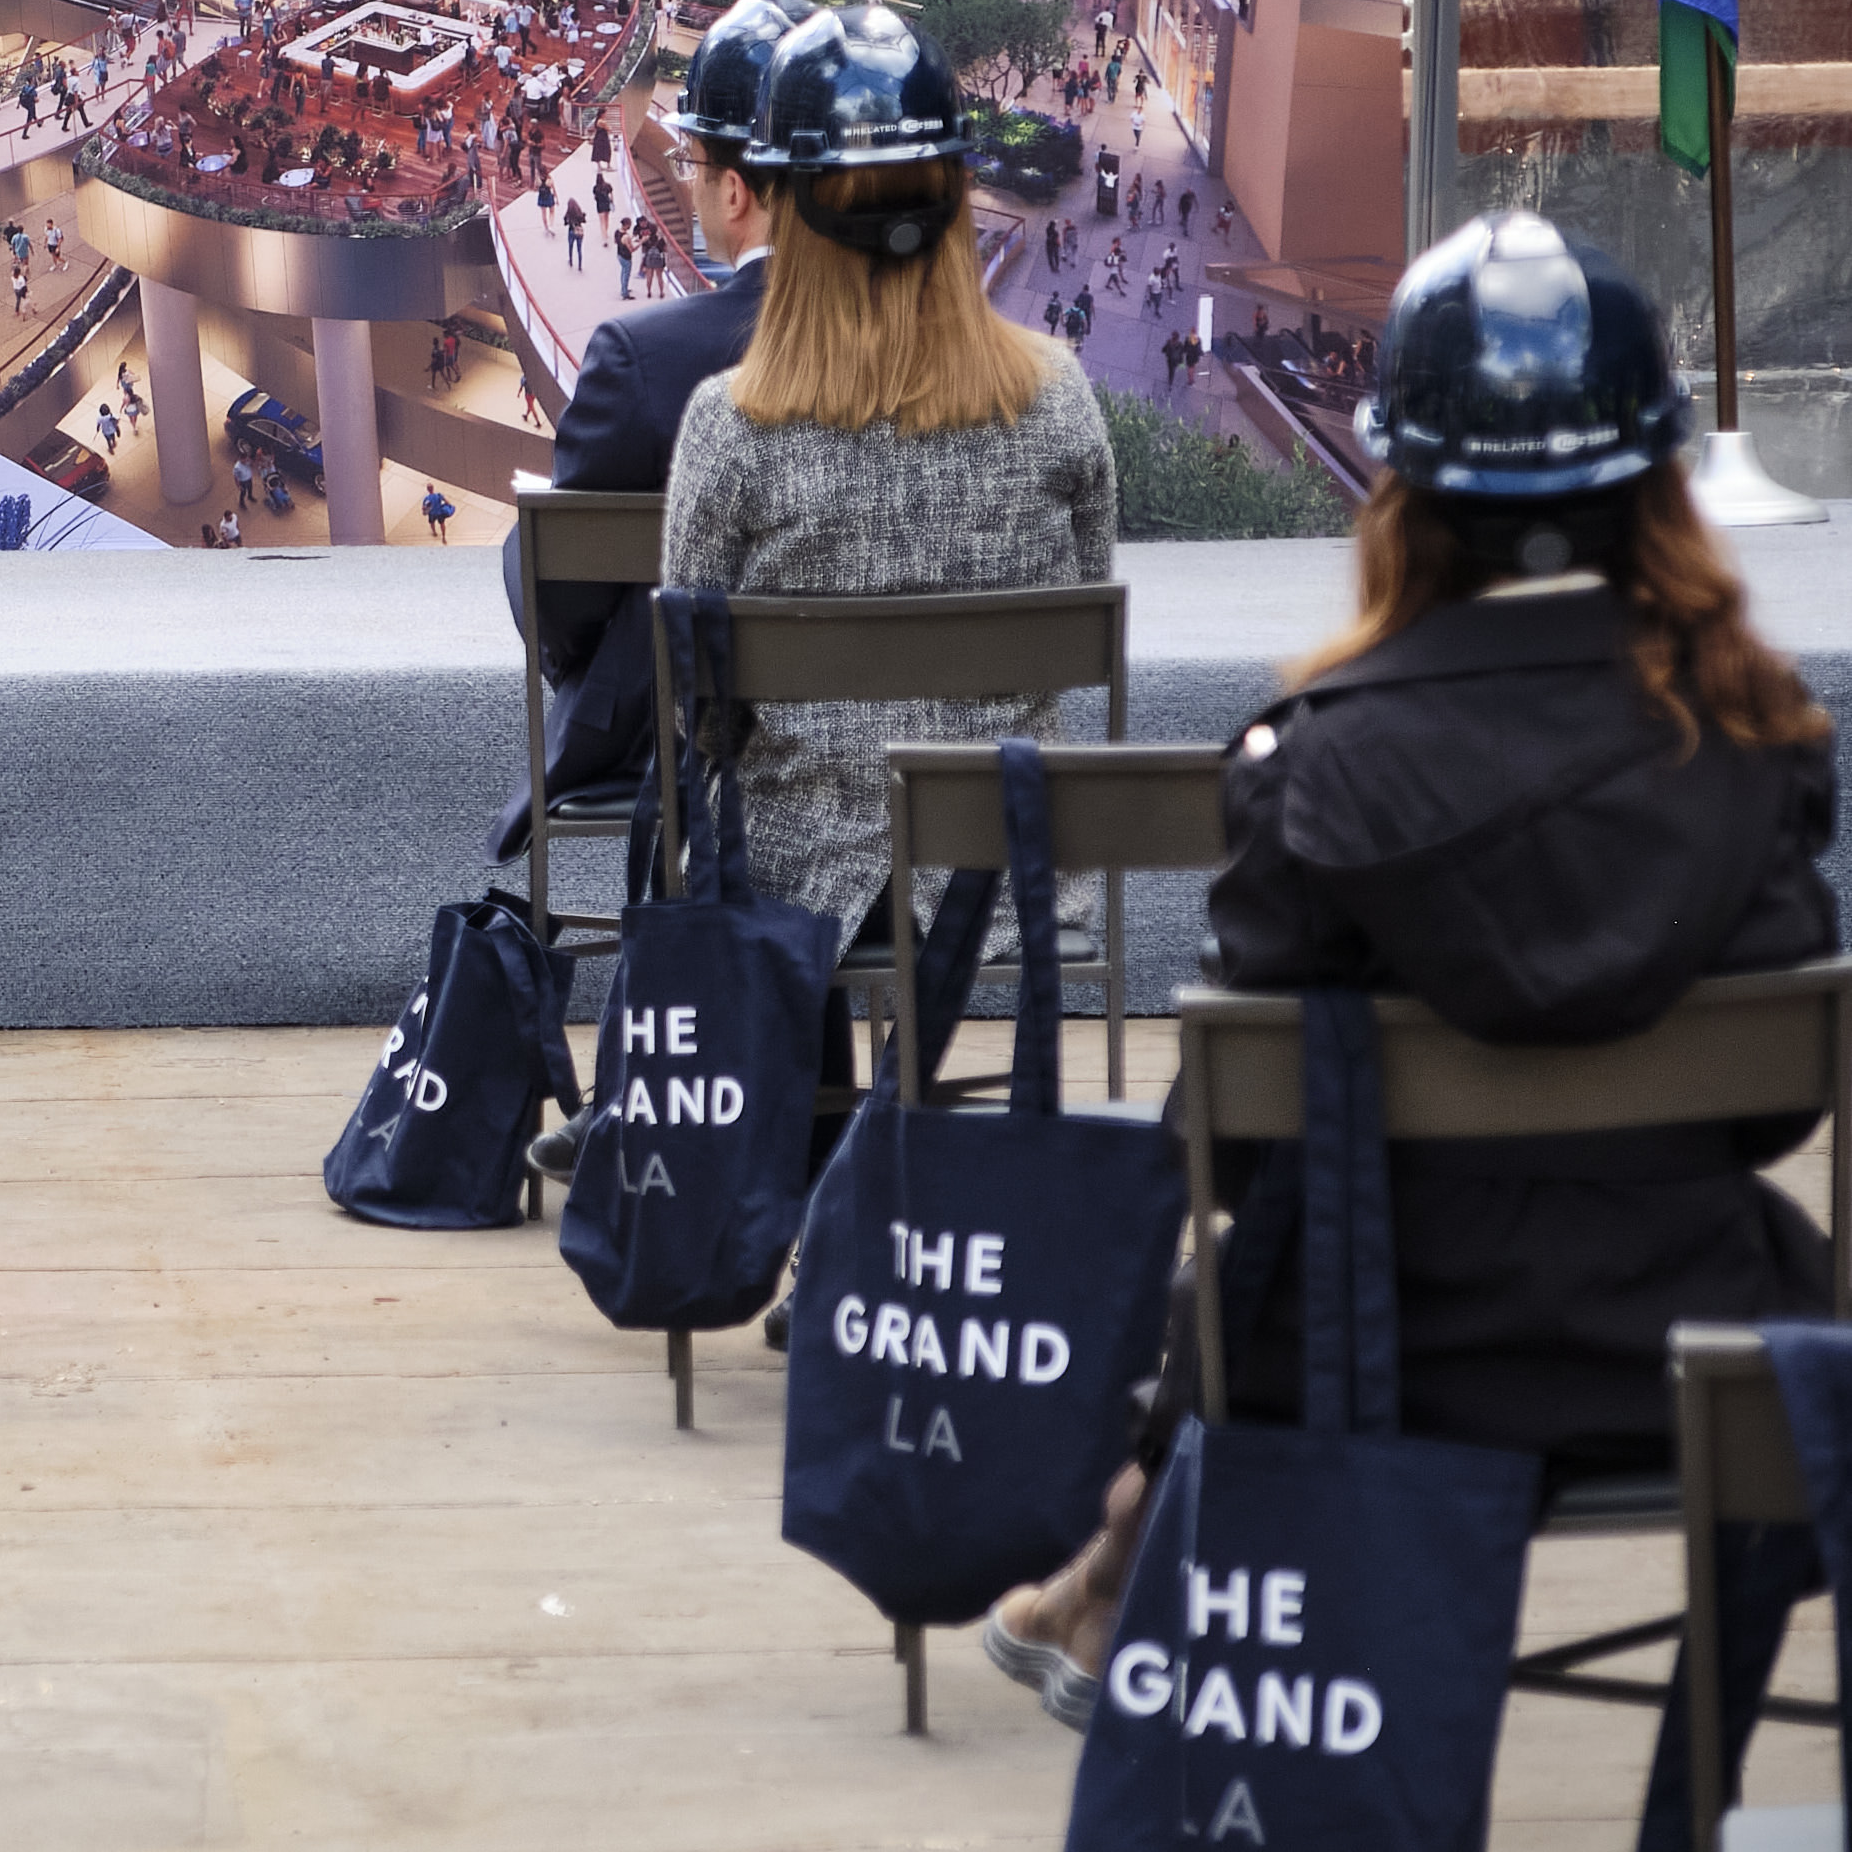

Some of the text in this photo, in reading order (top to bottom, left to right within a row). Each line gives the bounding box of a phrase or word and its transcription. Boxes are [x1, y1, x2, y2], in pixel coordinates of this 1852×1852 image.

[622, 1006, 698, 1055] HE
[611, 1076, 745, 1125] AND
[890, 1221, 1005, 1294] THE
[834, 1294, 1071, 1385] GRAND
[886, 1395, 963, 1463] LA
[1181, 1560, 1306, 1644] HE
[1109, 1640, 1383, 1756] GAND
